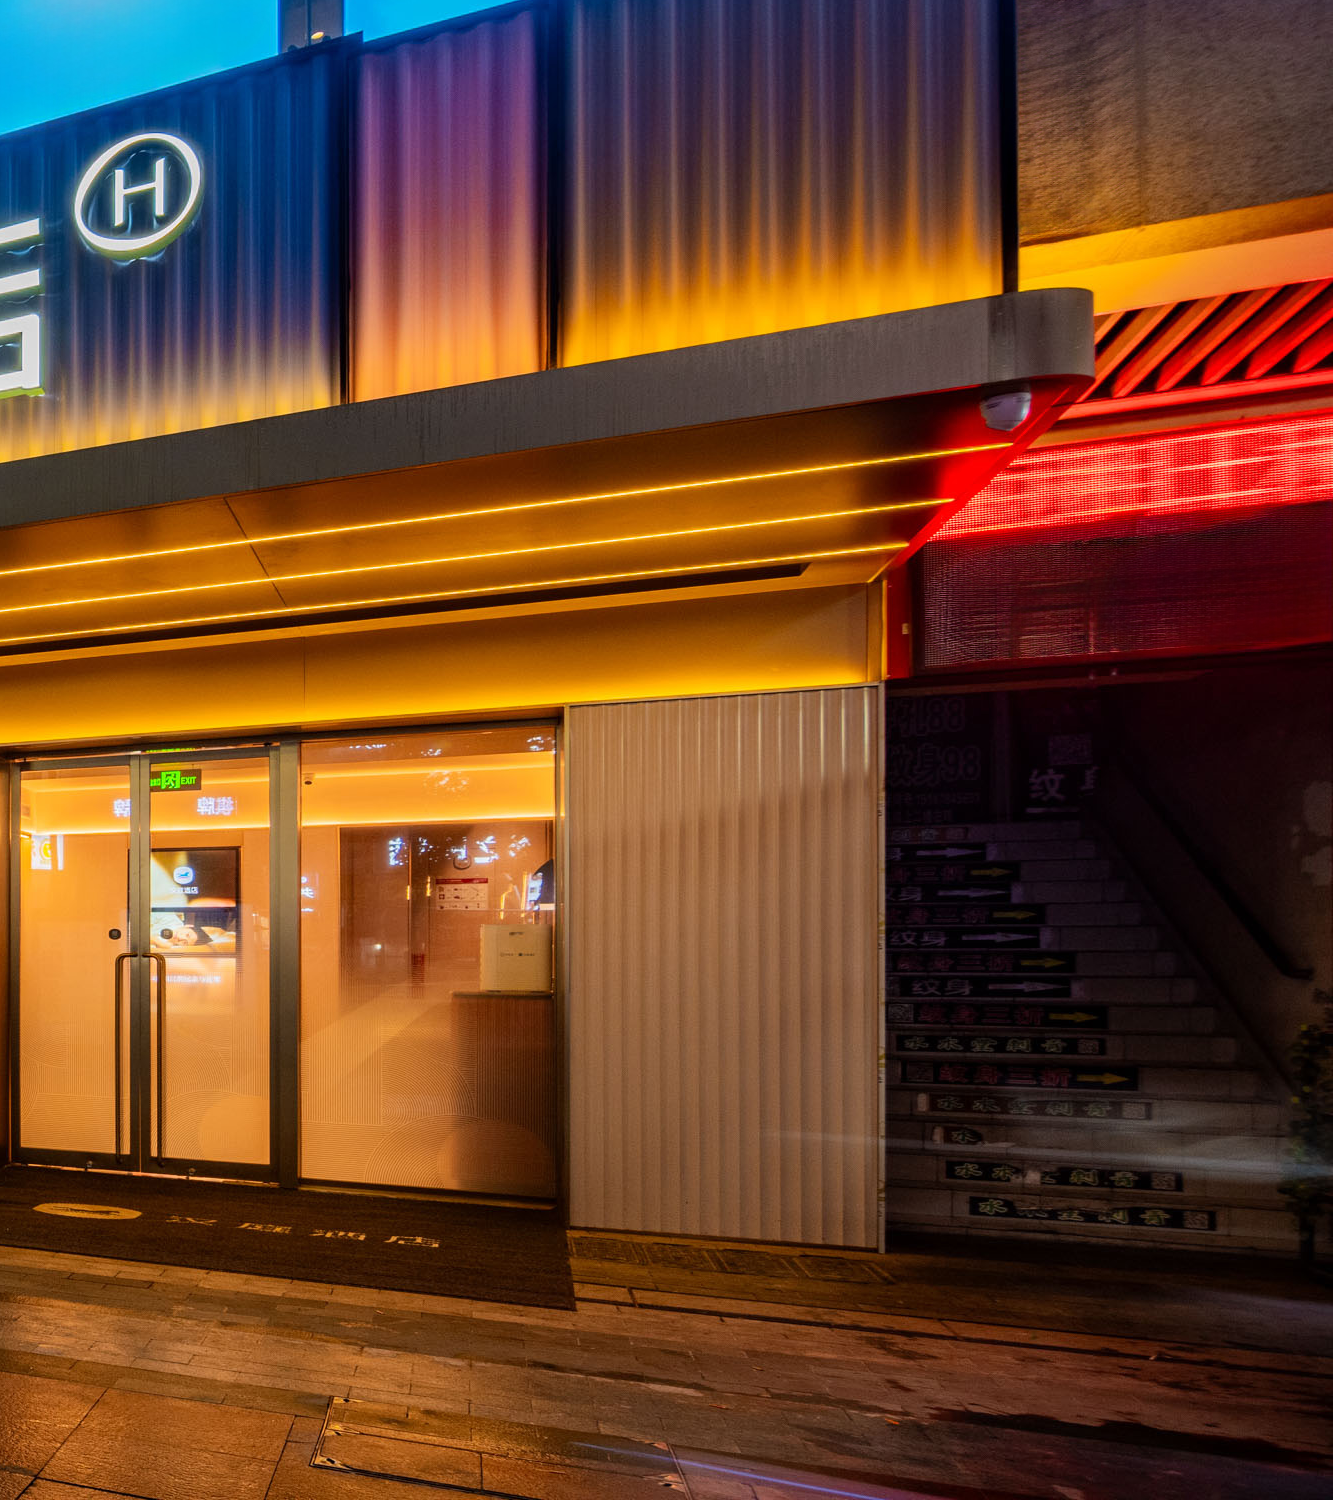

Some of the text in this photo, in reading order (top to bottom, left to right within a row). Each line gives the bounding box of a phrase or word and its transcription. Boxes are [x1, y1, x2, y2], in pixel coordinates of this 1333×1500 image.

[180, 776, 197, 785] EXIT
[889, 930, 949, 948] 纹身
[911, 979, 973, 997] 纹身
